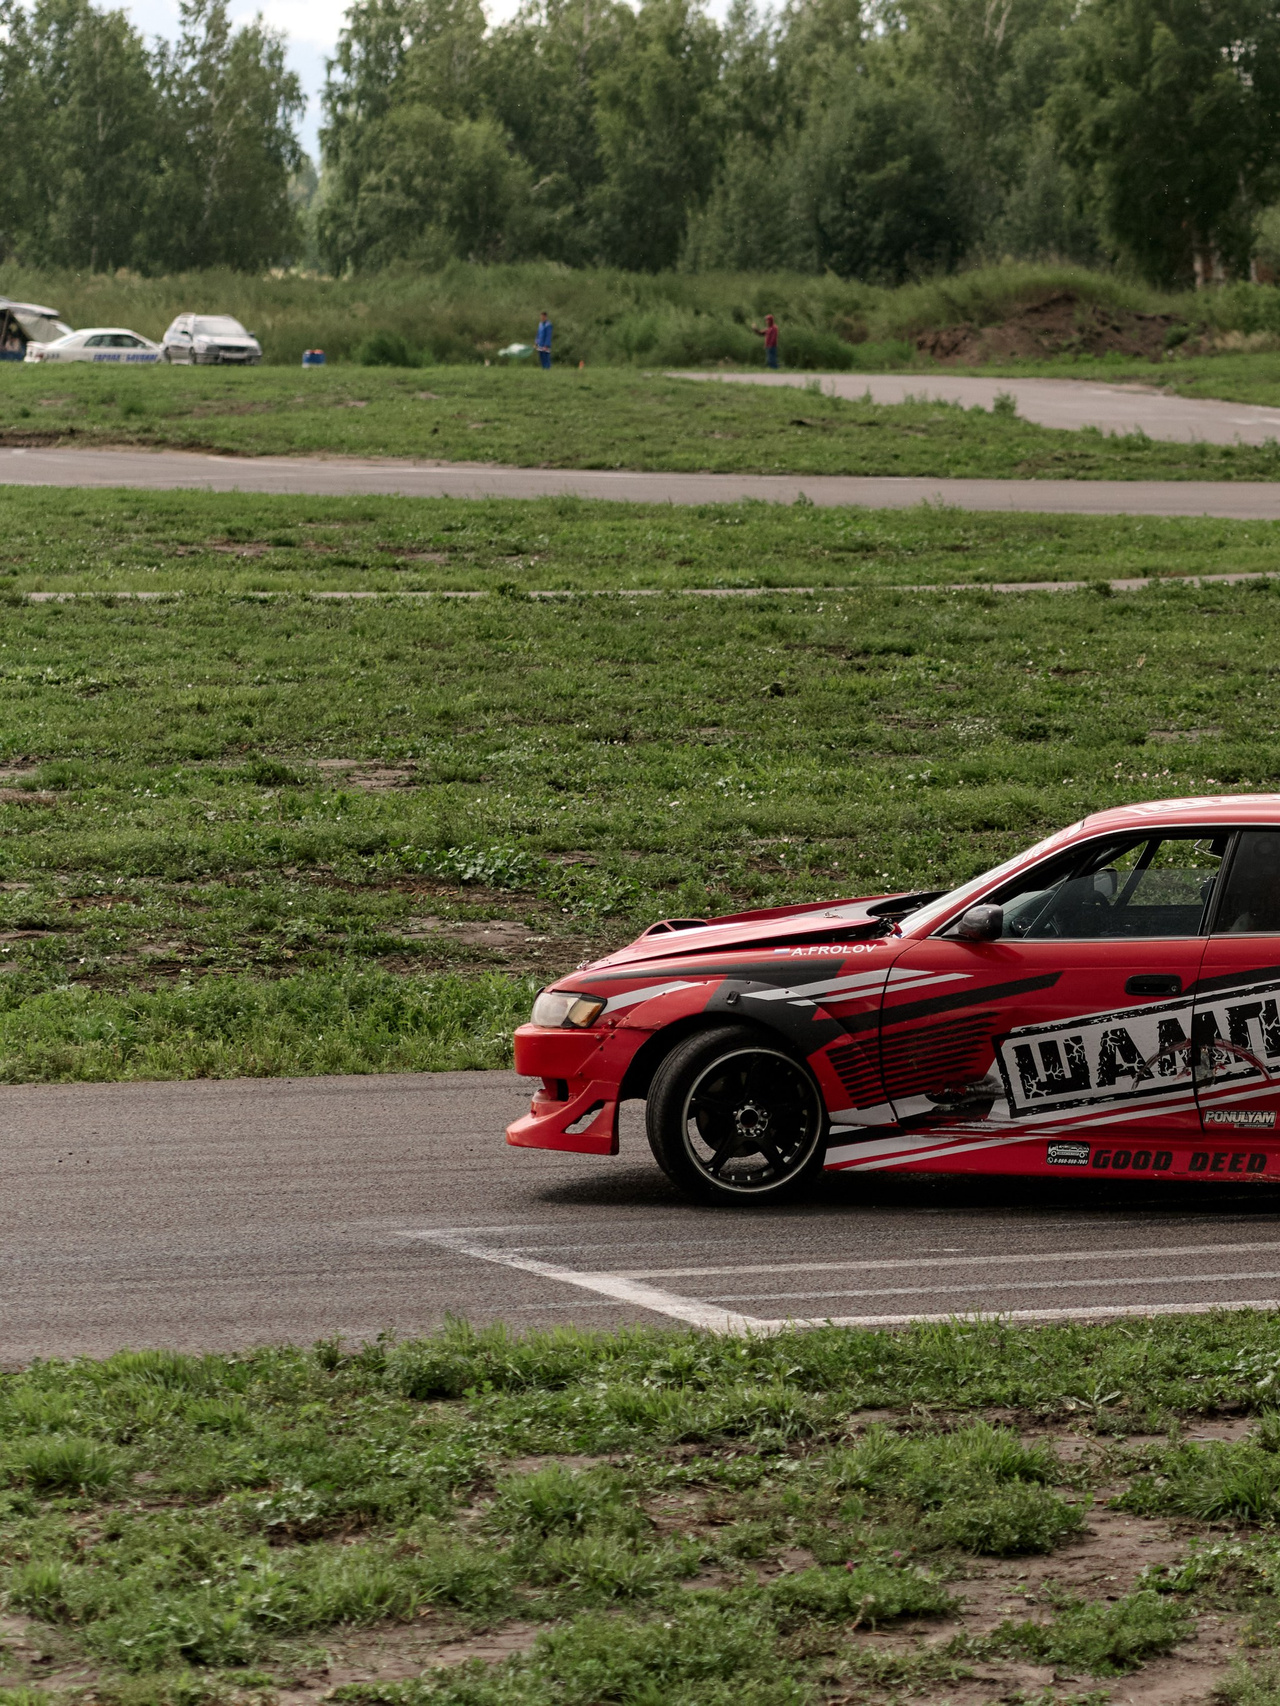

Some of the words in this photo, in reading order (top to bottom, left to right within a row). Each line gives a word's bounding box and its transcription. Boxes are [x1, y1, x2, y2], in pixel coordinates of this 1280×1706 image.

[791, 944, 877, 956] A.FROLOV
[1204, 1111, 1276, 1123] PONULYAM
[1092, 1150, 1173, 1171] GOOD
[1188, 1152, 1268, 1173] DEED
